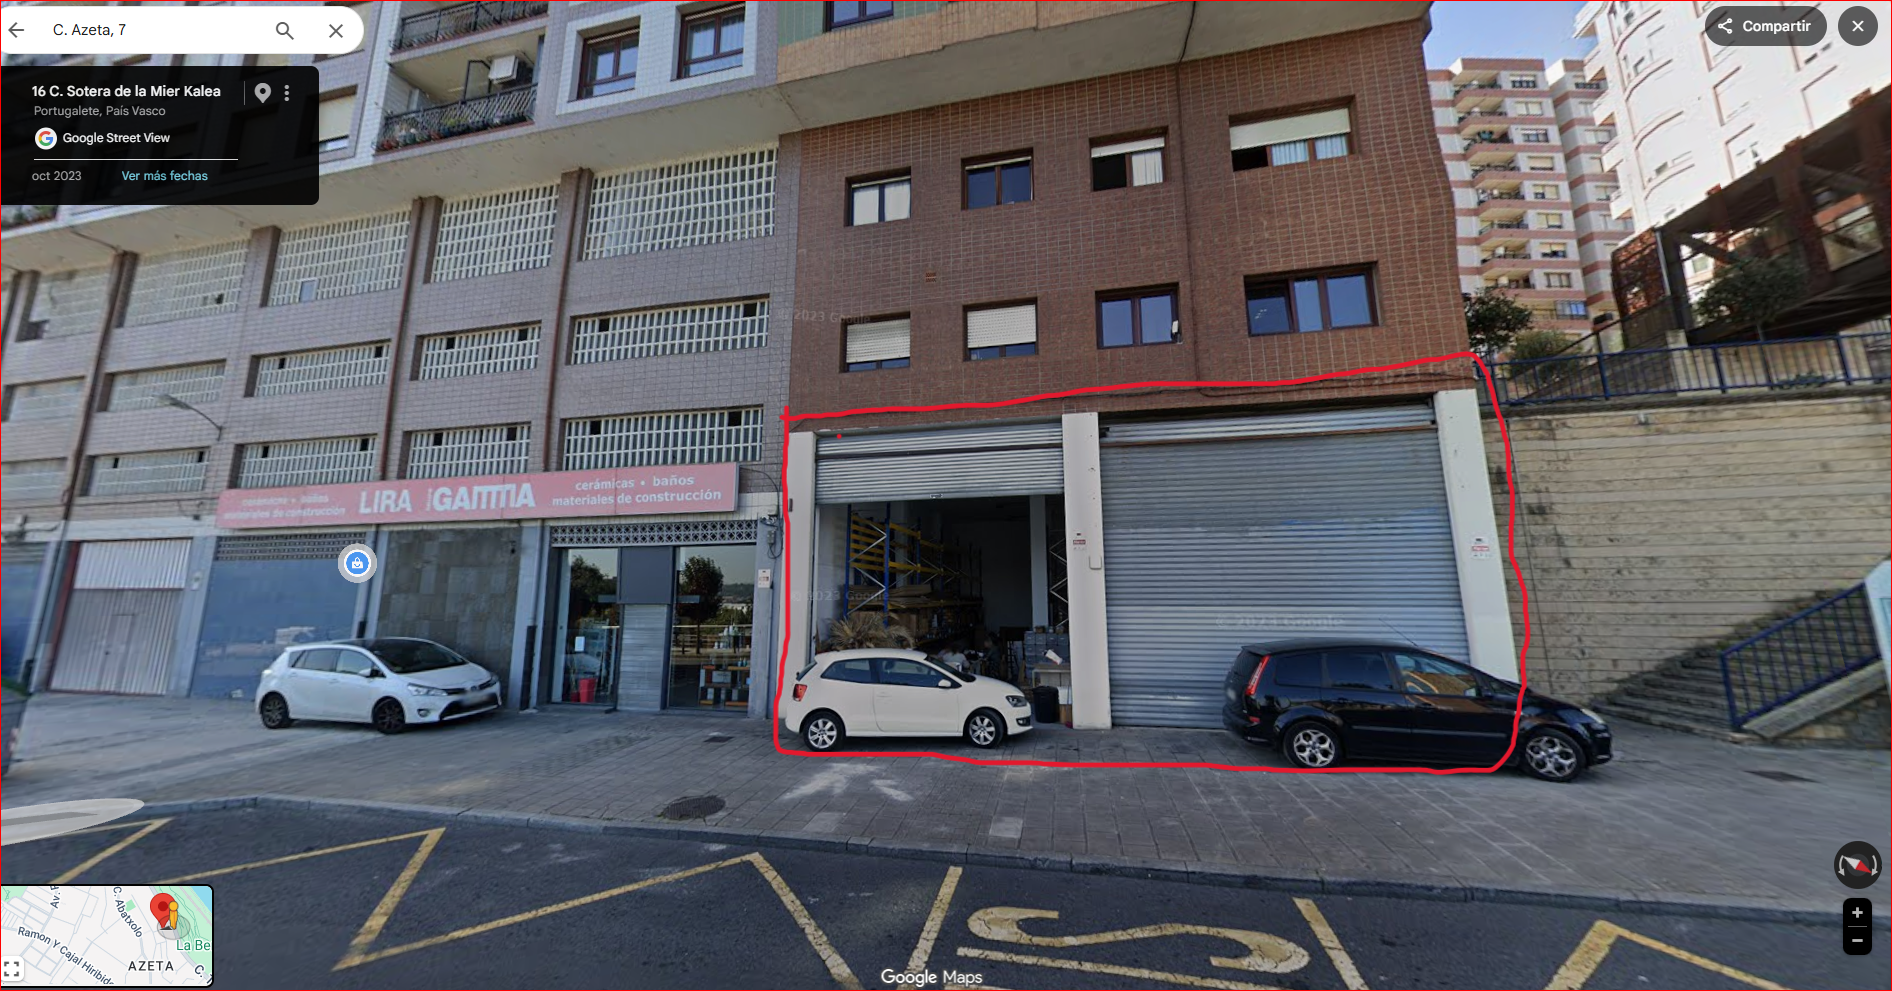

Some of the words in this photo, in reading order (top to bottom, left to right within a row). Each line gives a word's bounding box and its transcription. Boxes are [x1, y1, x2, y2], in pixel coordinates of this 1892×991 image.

[575, 478, 635, 491] cerámicas
[652, 474, 696, 487] baños
[358, 488, 412, 514] LIRA
[552, 493, 614, 506] materiales
[617, 492, 632, 504] de
[635, 488, 722, 503] construcción
